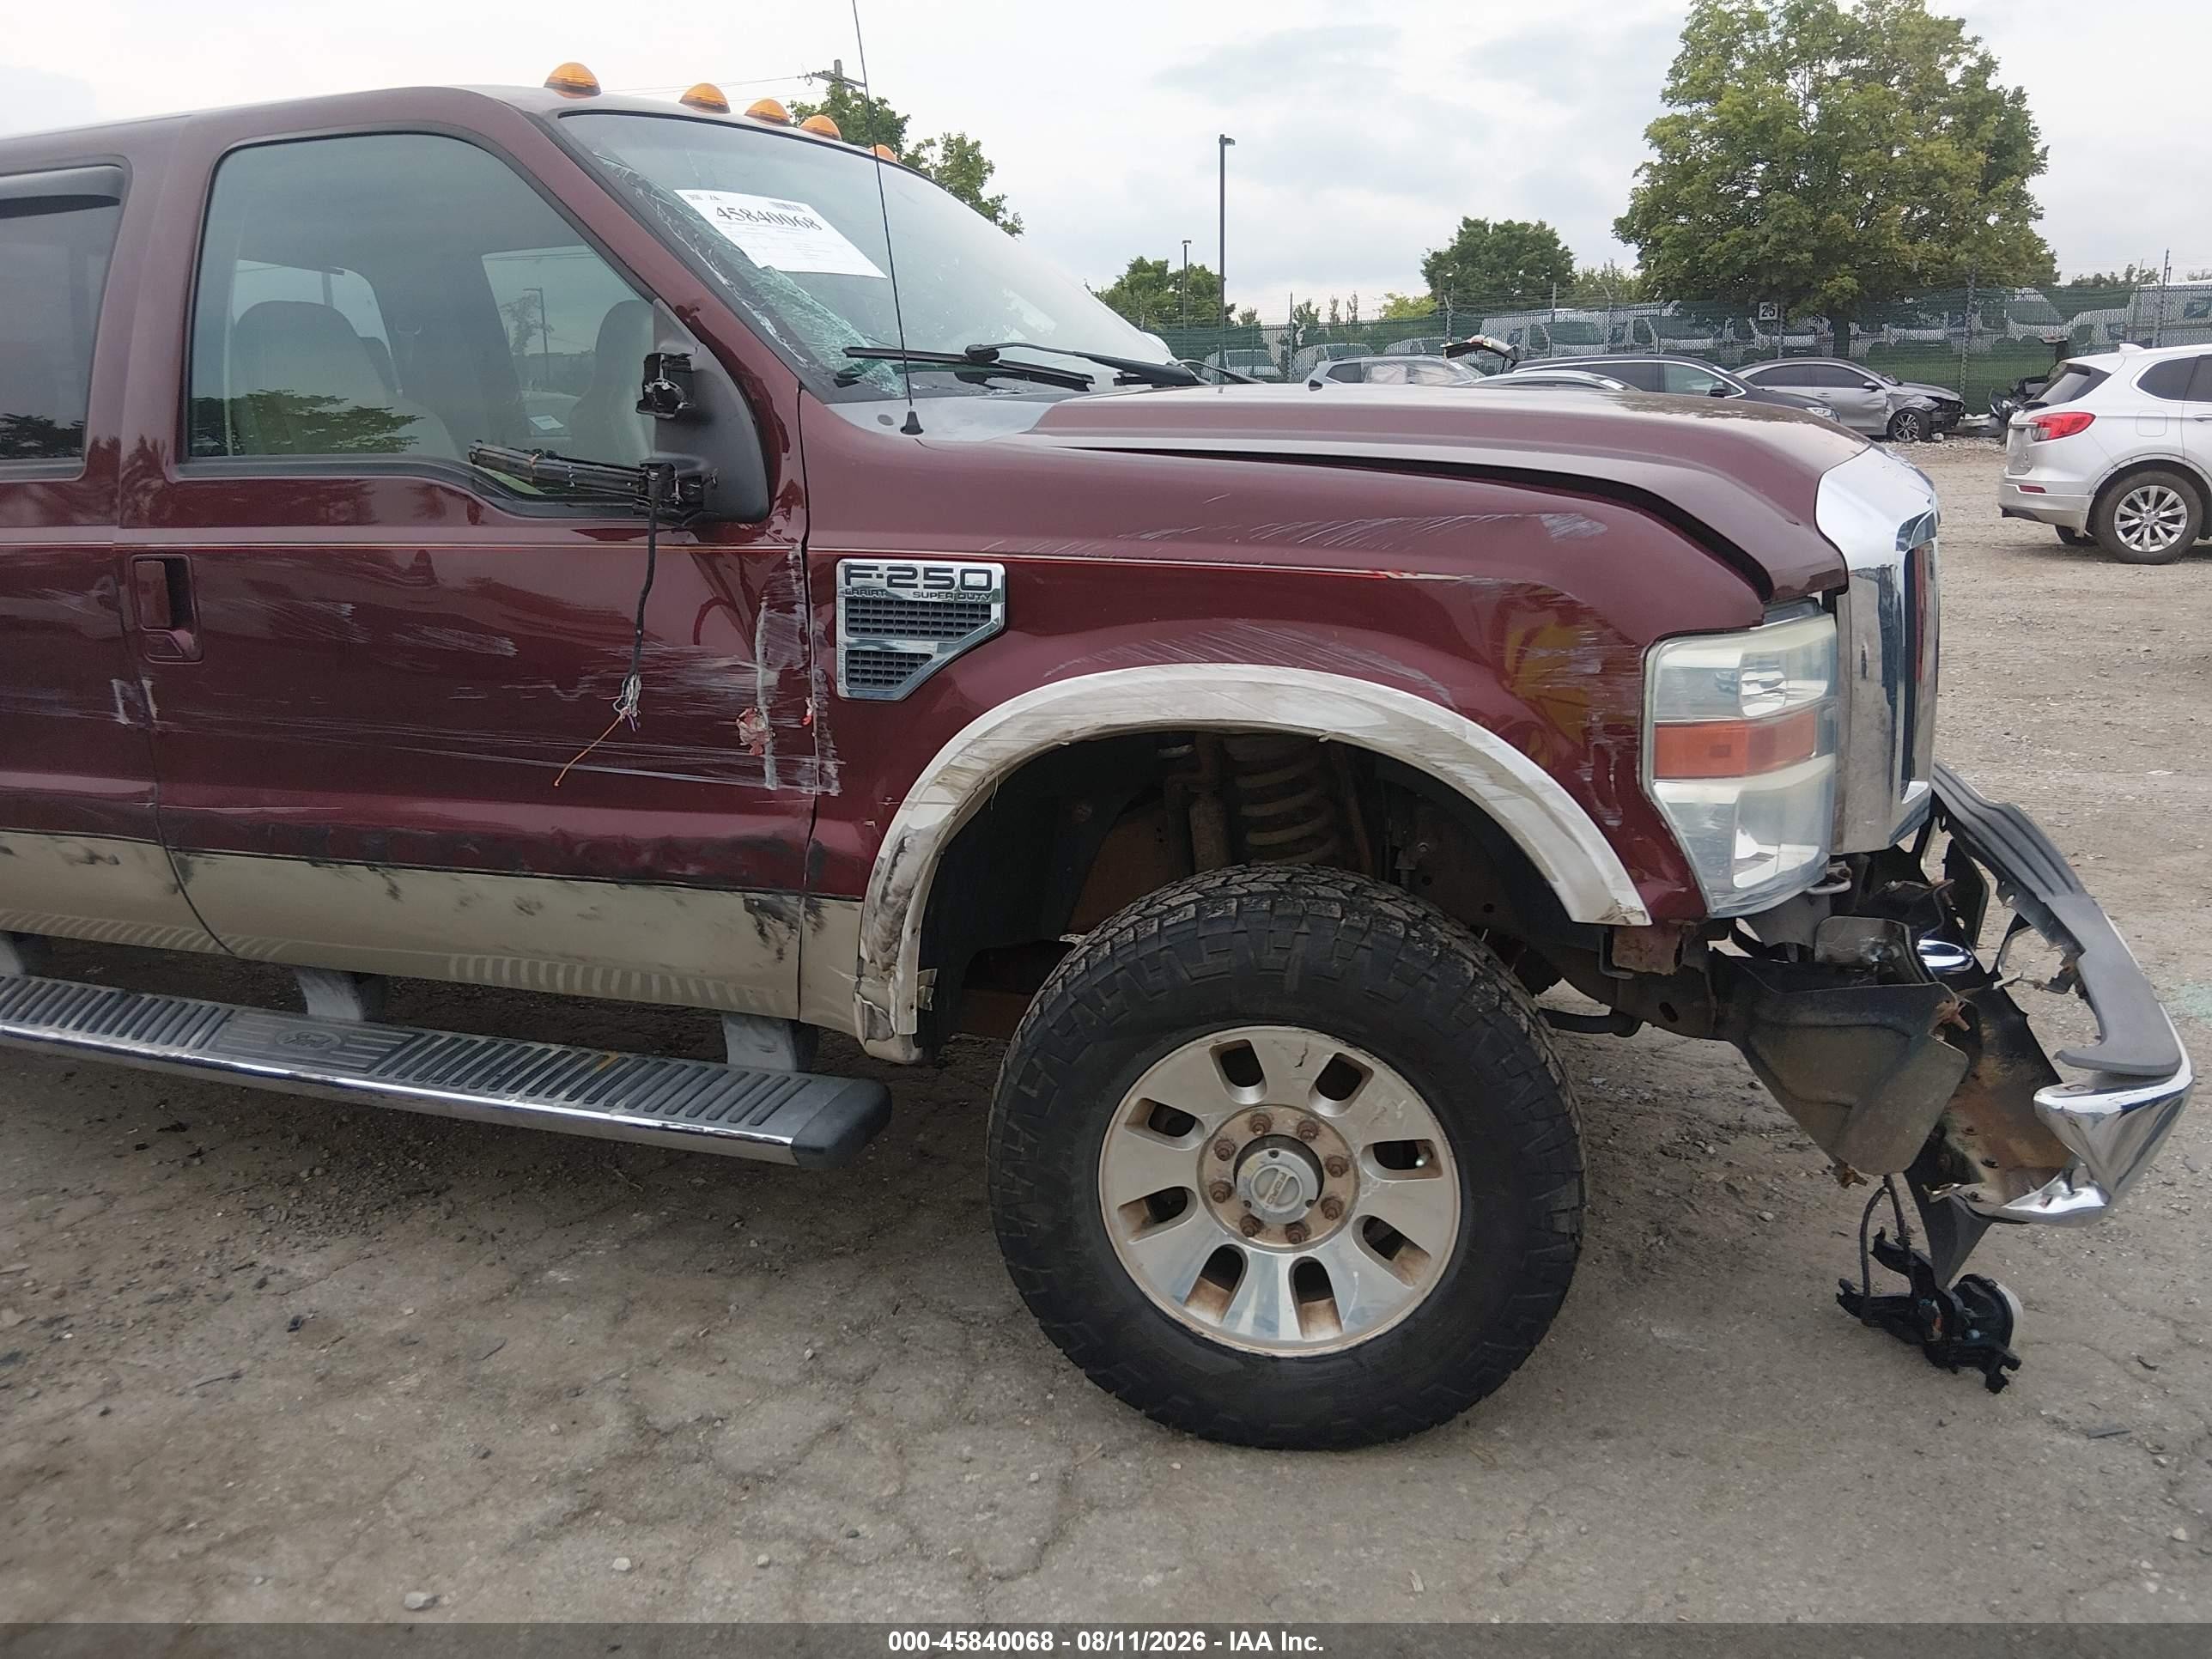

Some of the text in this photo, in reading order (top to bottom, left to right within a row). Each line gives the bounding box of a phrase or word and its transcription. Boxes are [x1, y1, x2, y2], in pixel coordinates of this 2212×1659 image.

[715, 206, 823, 232] 45840068
[844, 564, 993, 592] F-250
[912, 591, 992, 602] SUPER DUTY
[1266, 1171, 1288, 1205] FORD
